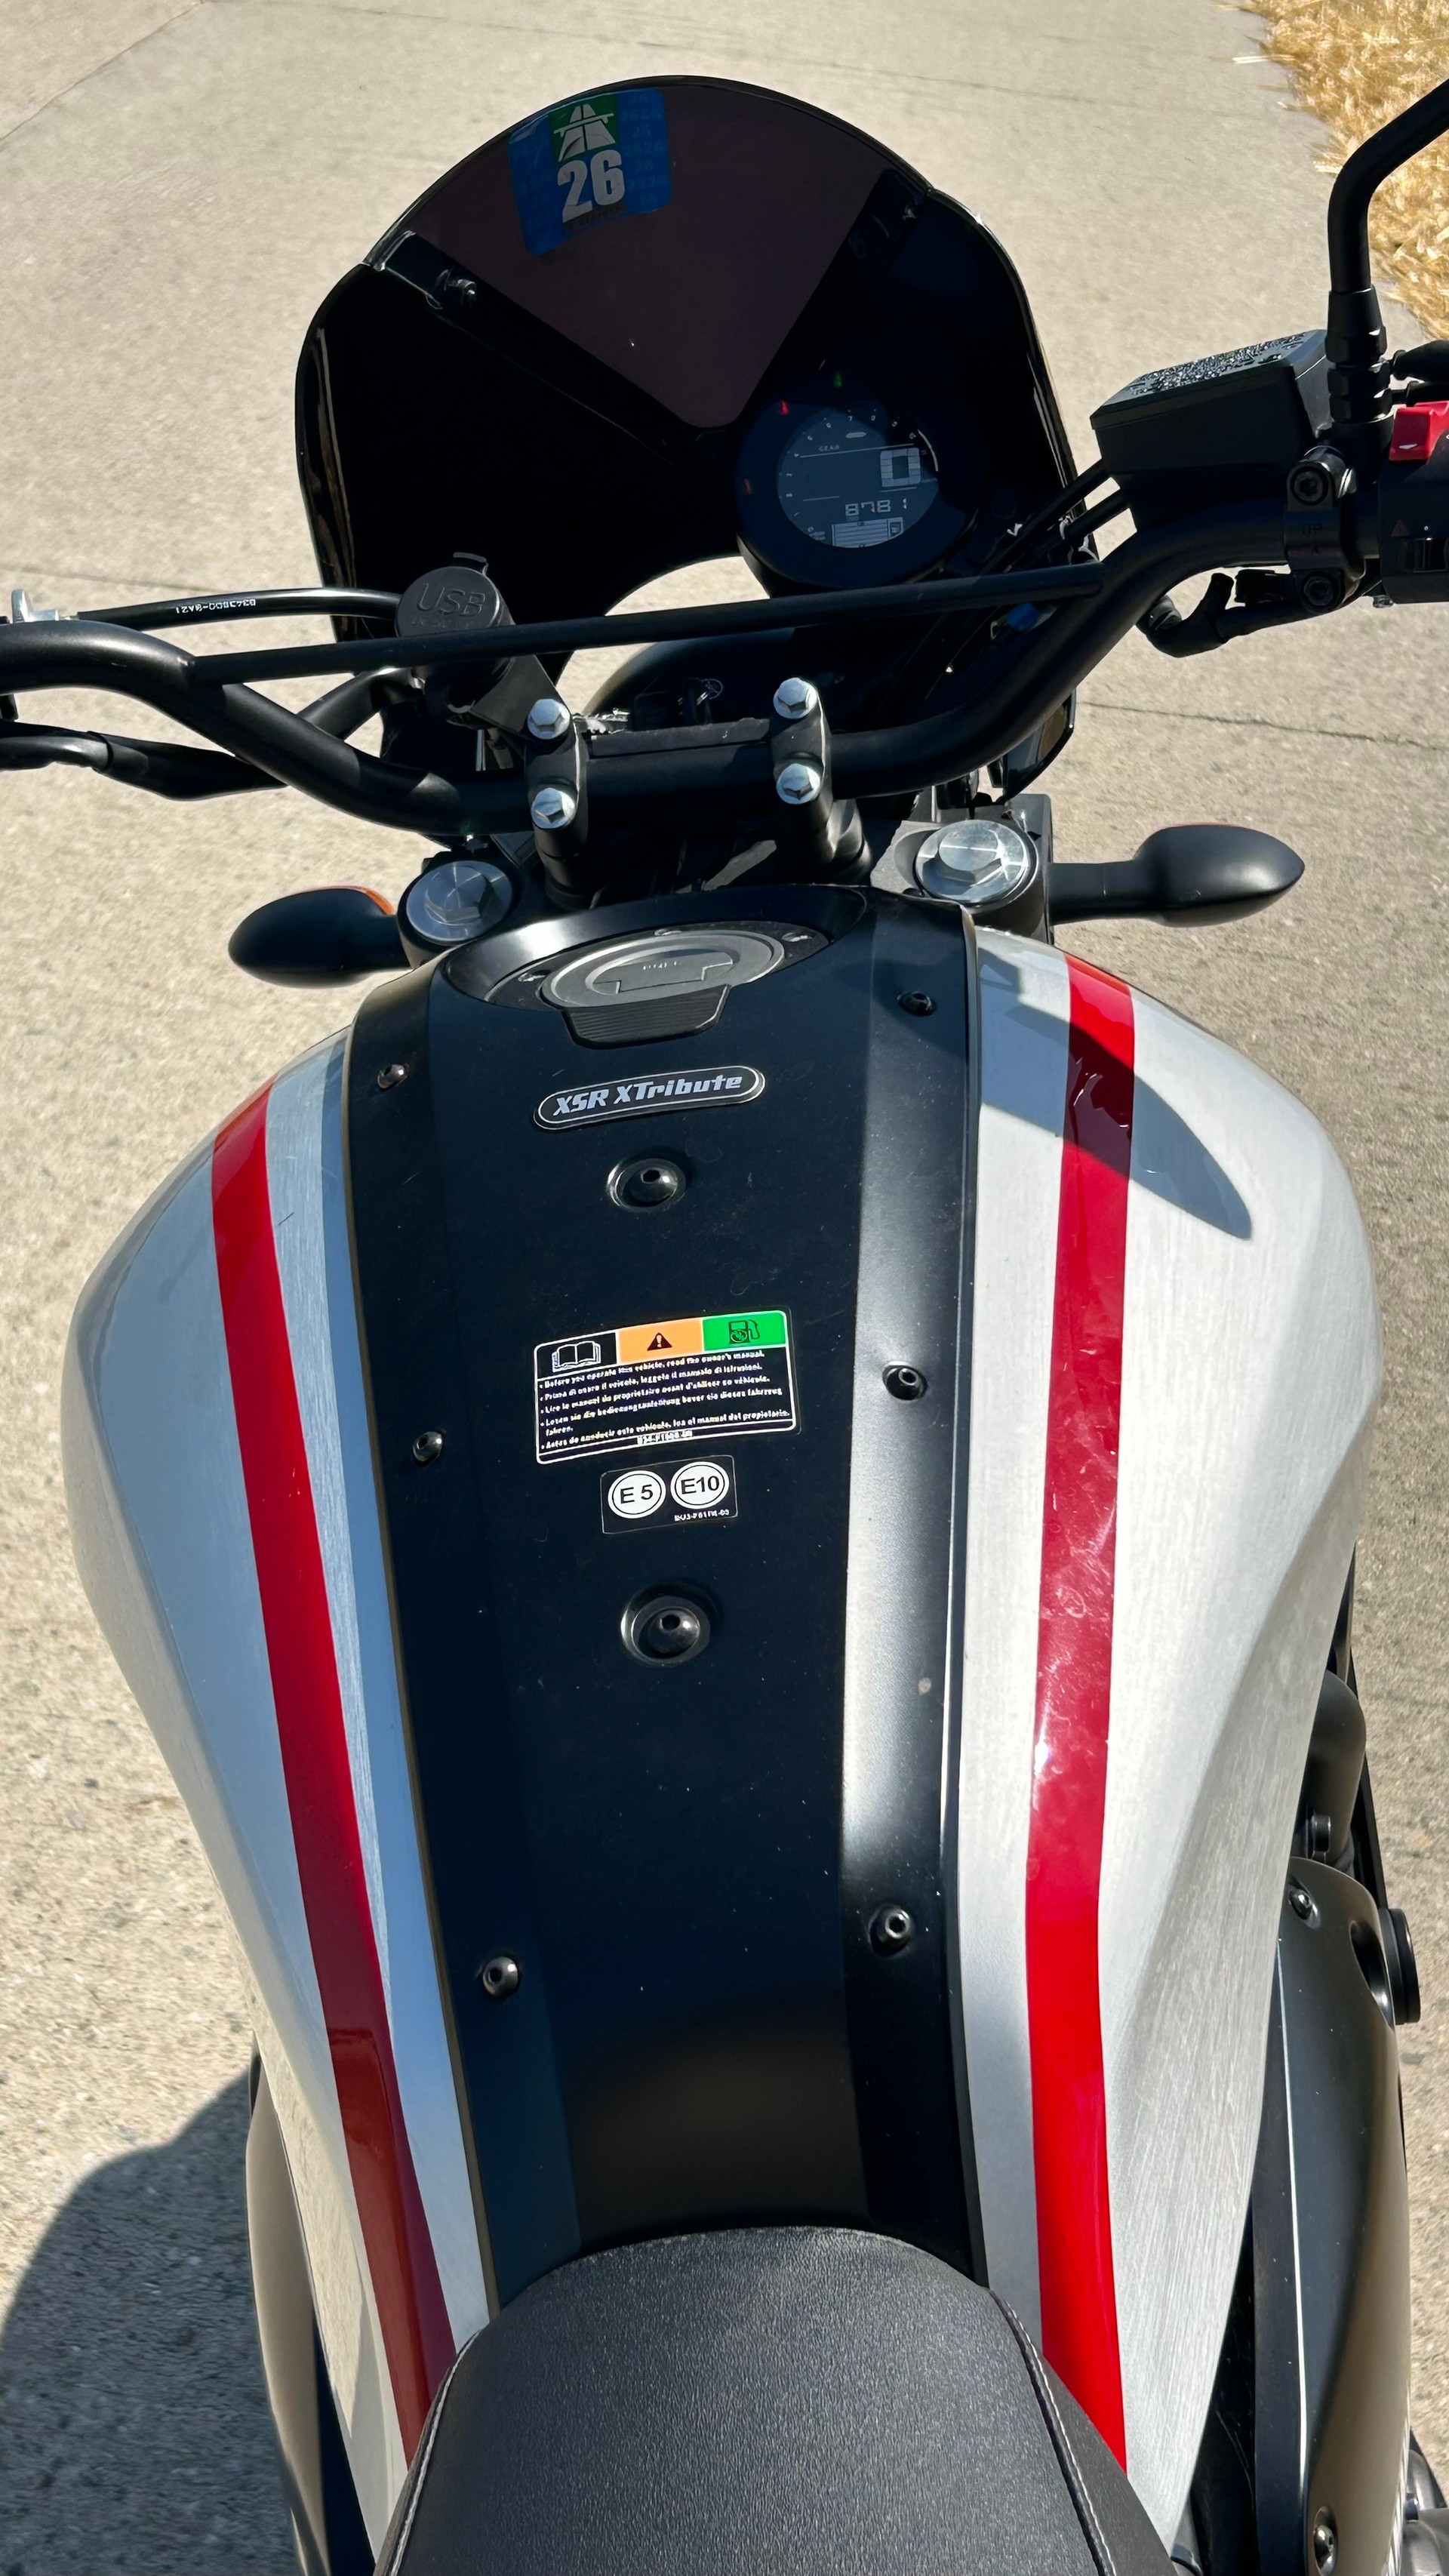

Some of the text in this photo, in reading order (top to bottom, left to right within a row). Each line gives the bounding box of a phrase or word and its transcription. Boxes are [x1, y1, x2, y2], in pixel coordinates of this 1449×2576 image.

[557, 149, 626, 223] 26
[880, 448, 921, 488] 0
[417, 583, 486, 617] USB
[553, 1074, 743, 1116] XSR XTribute
[681, 1476, 720, 1495] E10
